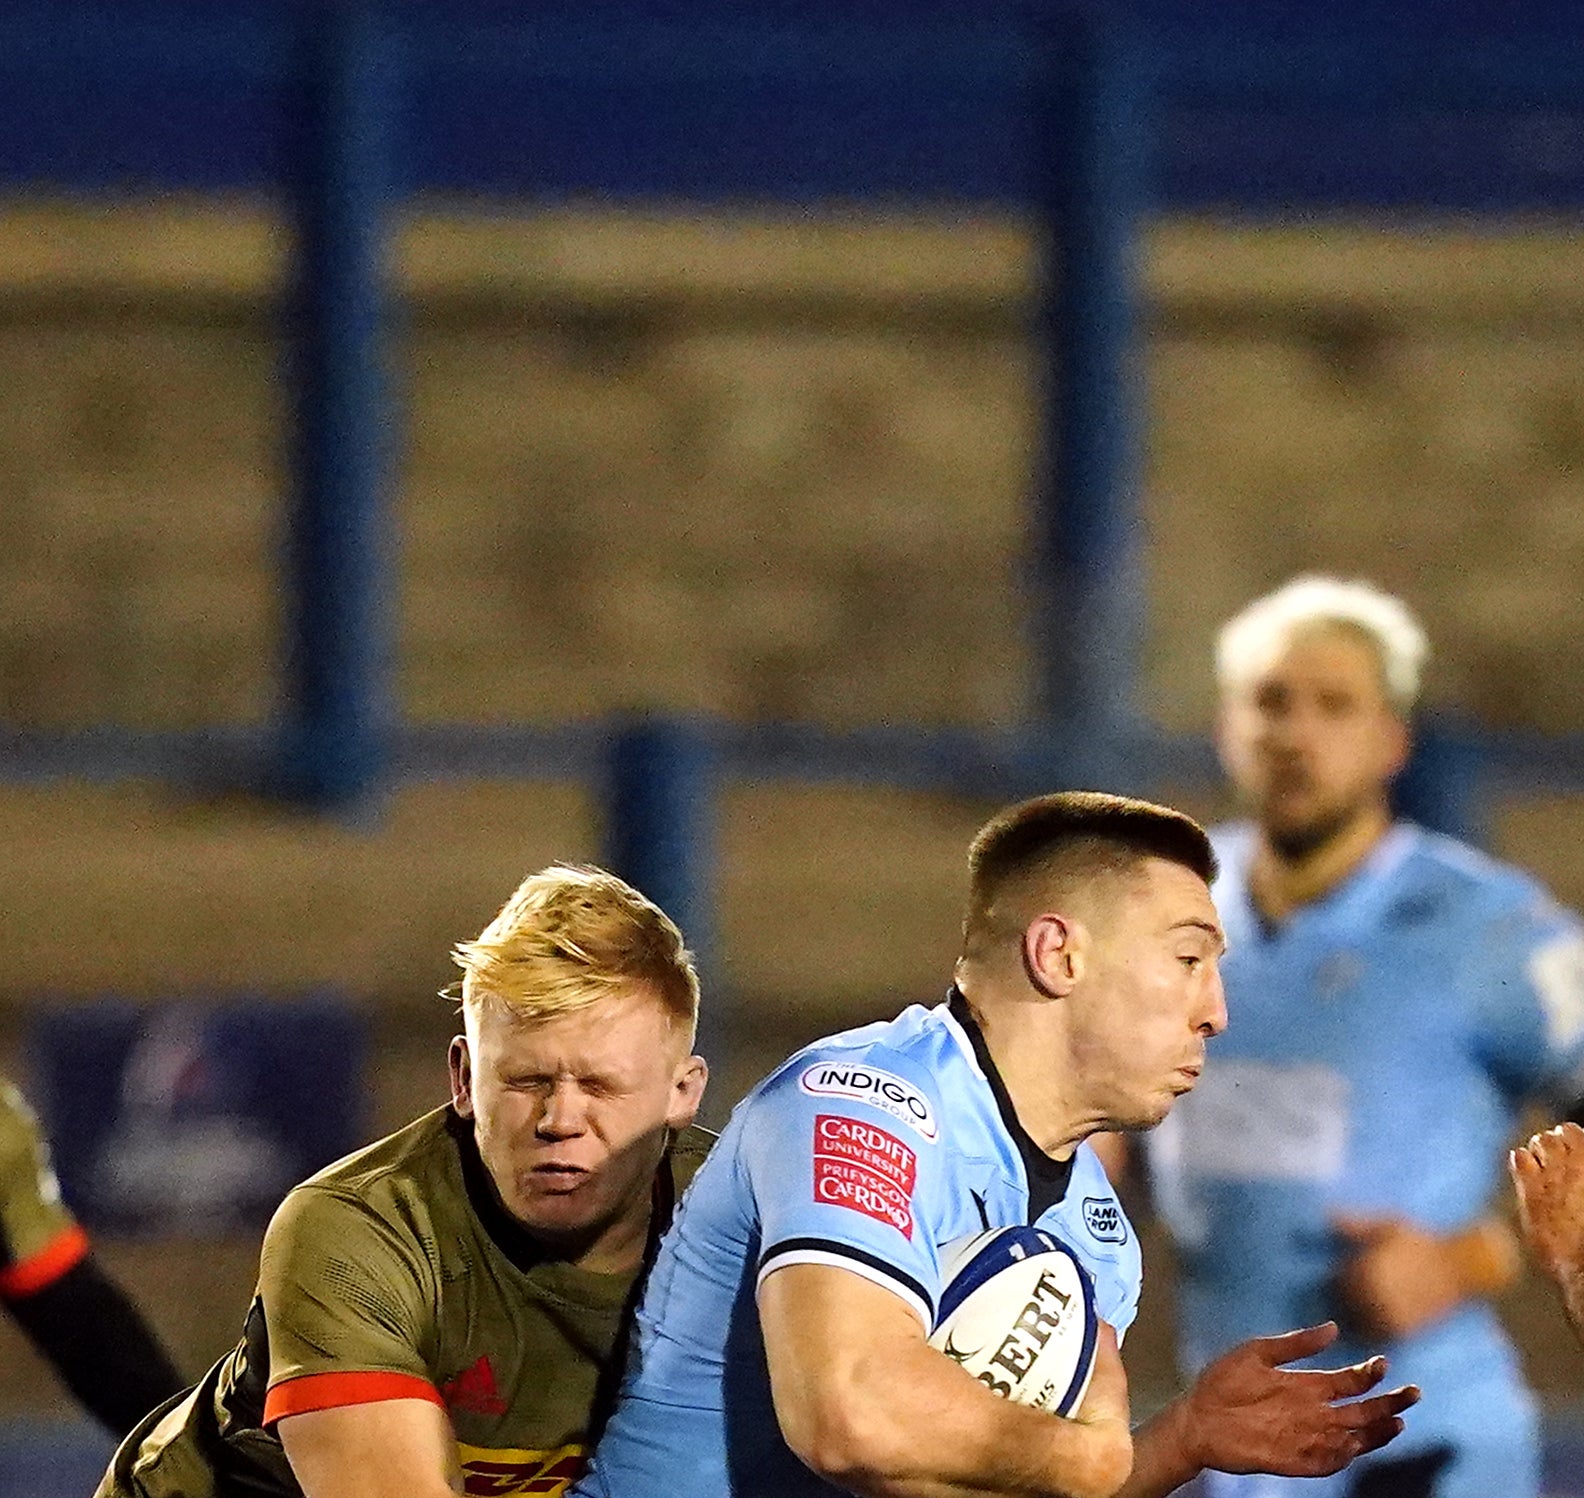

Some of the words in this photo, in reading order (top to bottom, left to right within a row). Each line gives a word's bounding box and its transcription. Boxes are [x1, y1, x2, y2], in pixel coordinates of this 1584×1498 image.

[819, 1070, 927, 1120] INDIGO
[869, 1096, 916, 1125] GROUP
[820, 1119, 914, 1170] CARDIFF
[823, 1141, 909, 1185] UNIVERSITY
[823, 1164, 909, 1209] PRIFYSGOL
